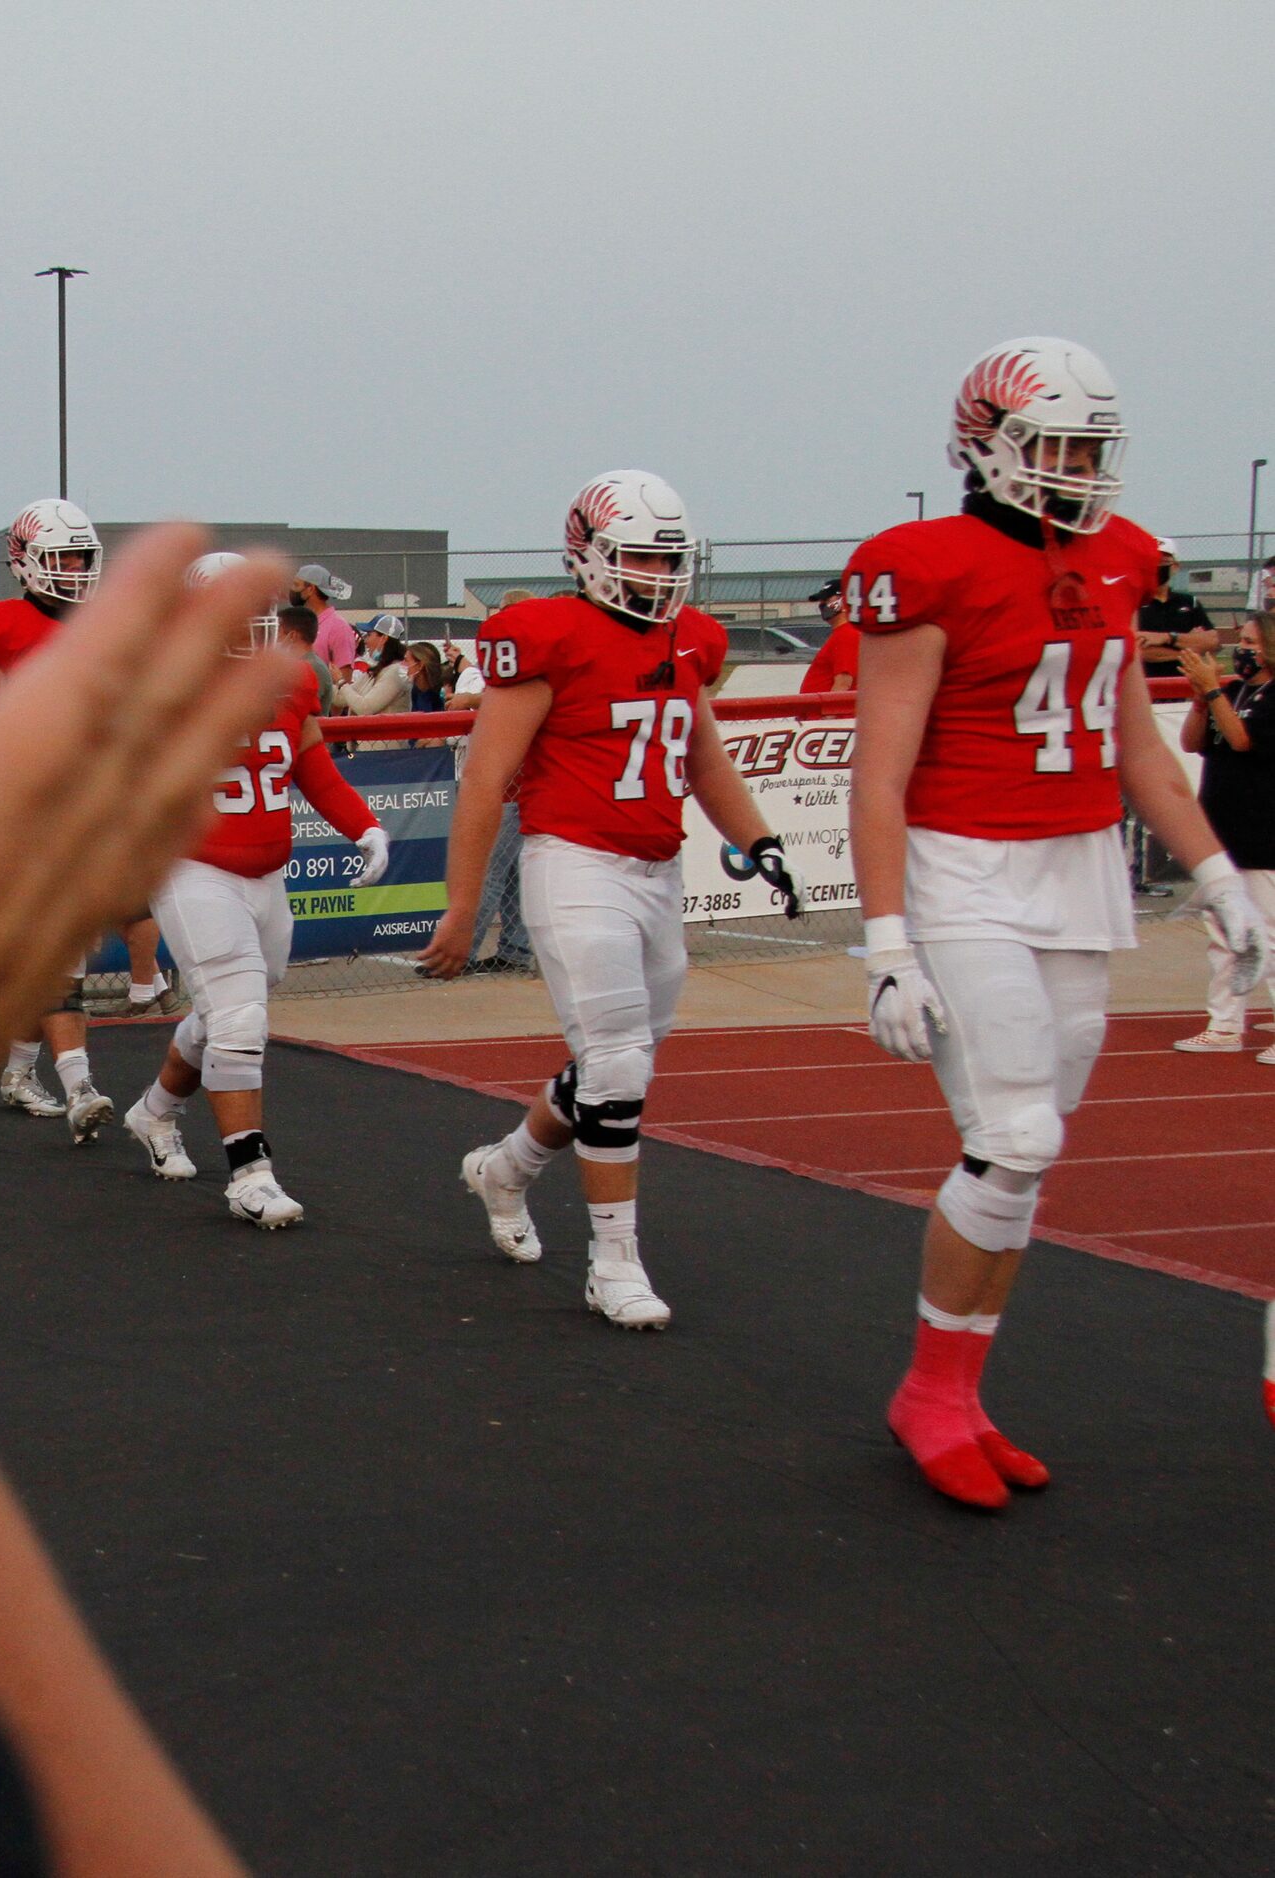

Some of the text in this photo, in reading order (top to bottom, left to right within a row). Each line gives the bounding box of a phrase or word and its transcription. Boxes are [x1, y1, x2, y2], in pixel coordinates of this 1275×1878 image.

[845, 573, 898, 623] 44
[477, 639, 518, 679] 78
[1013, 637, 1126, 773] 44
[610, 698, 693, 800] 78
[212, 730, 293, 814] 52
[759, 775, 826, 794] Powersports
[830, 774, 851, 788] Sto
[367, 790, 449, 810] REAL ESTATE
[805, 789, 839, 807] With
[780, 828, 850, 847] MW MOTO
[828, 838, 844, 859] of
[306, 857, 335, 878] 891
[341, 855, 367, 876] 29
[289, 894, 355, 915] EX PAYNE
